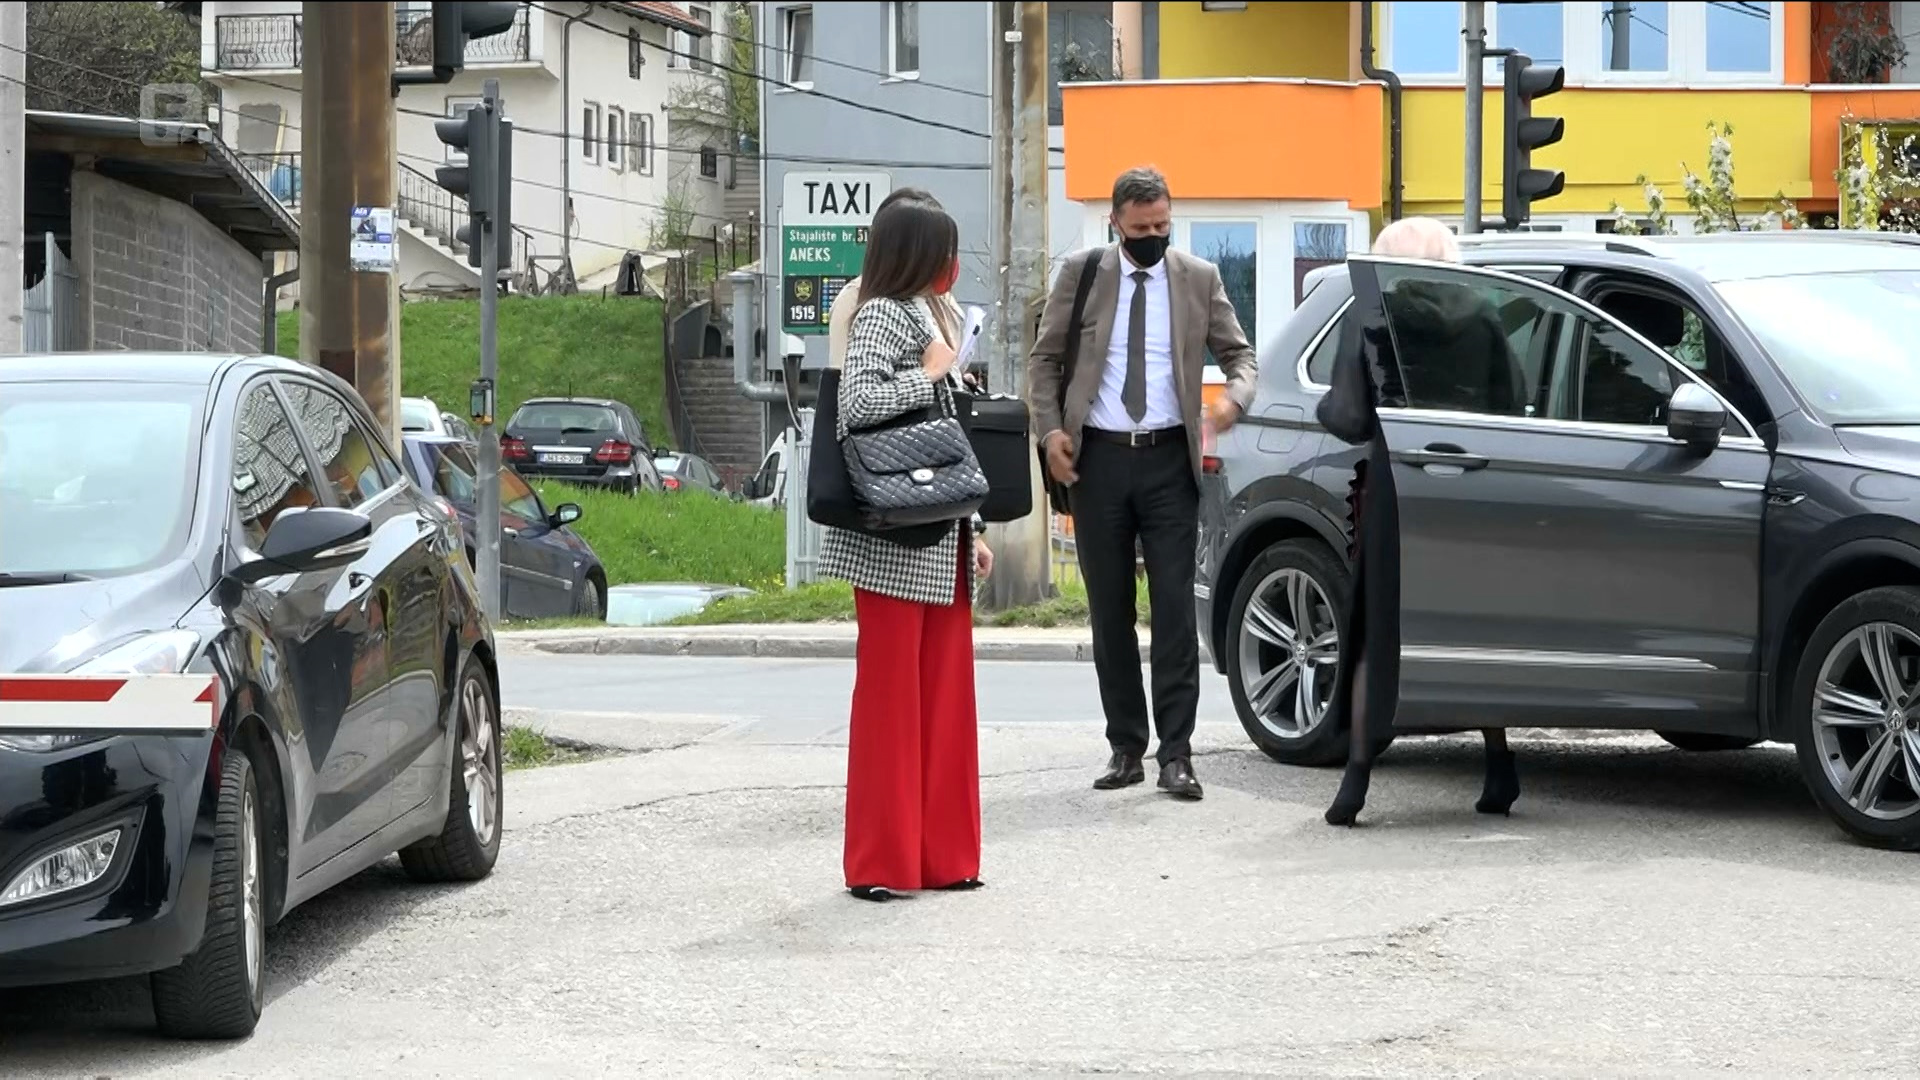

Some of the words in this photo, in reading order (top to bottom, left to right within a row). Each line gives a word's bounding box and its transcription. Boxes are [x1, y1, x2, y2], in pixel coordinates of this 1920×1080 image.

[803, 181, 871, 215] TAXI
[789, 247, 831, 262] ANEKS
[790, 305, 815, 320] 1515
